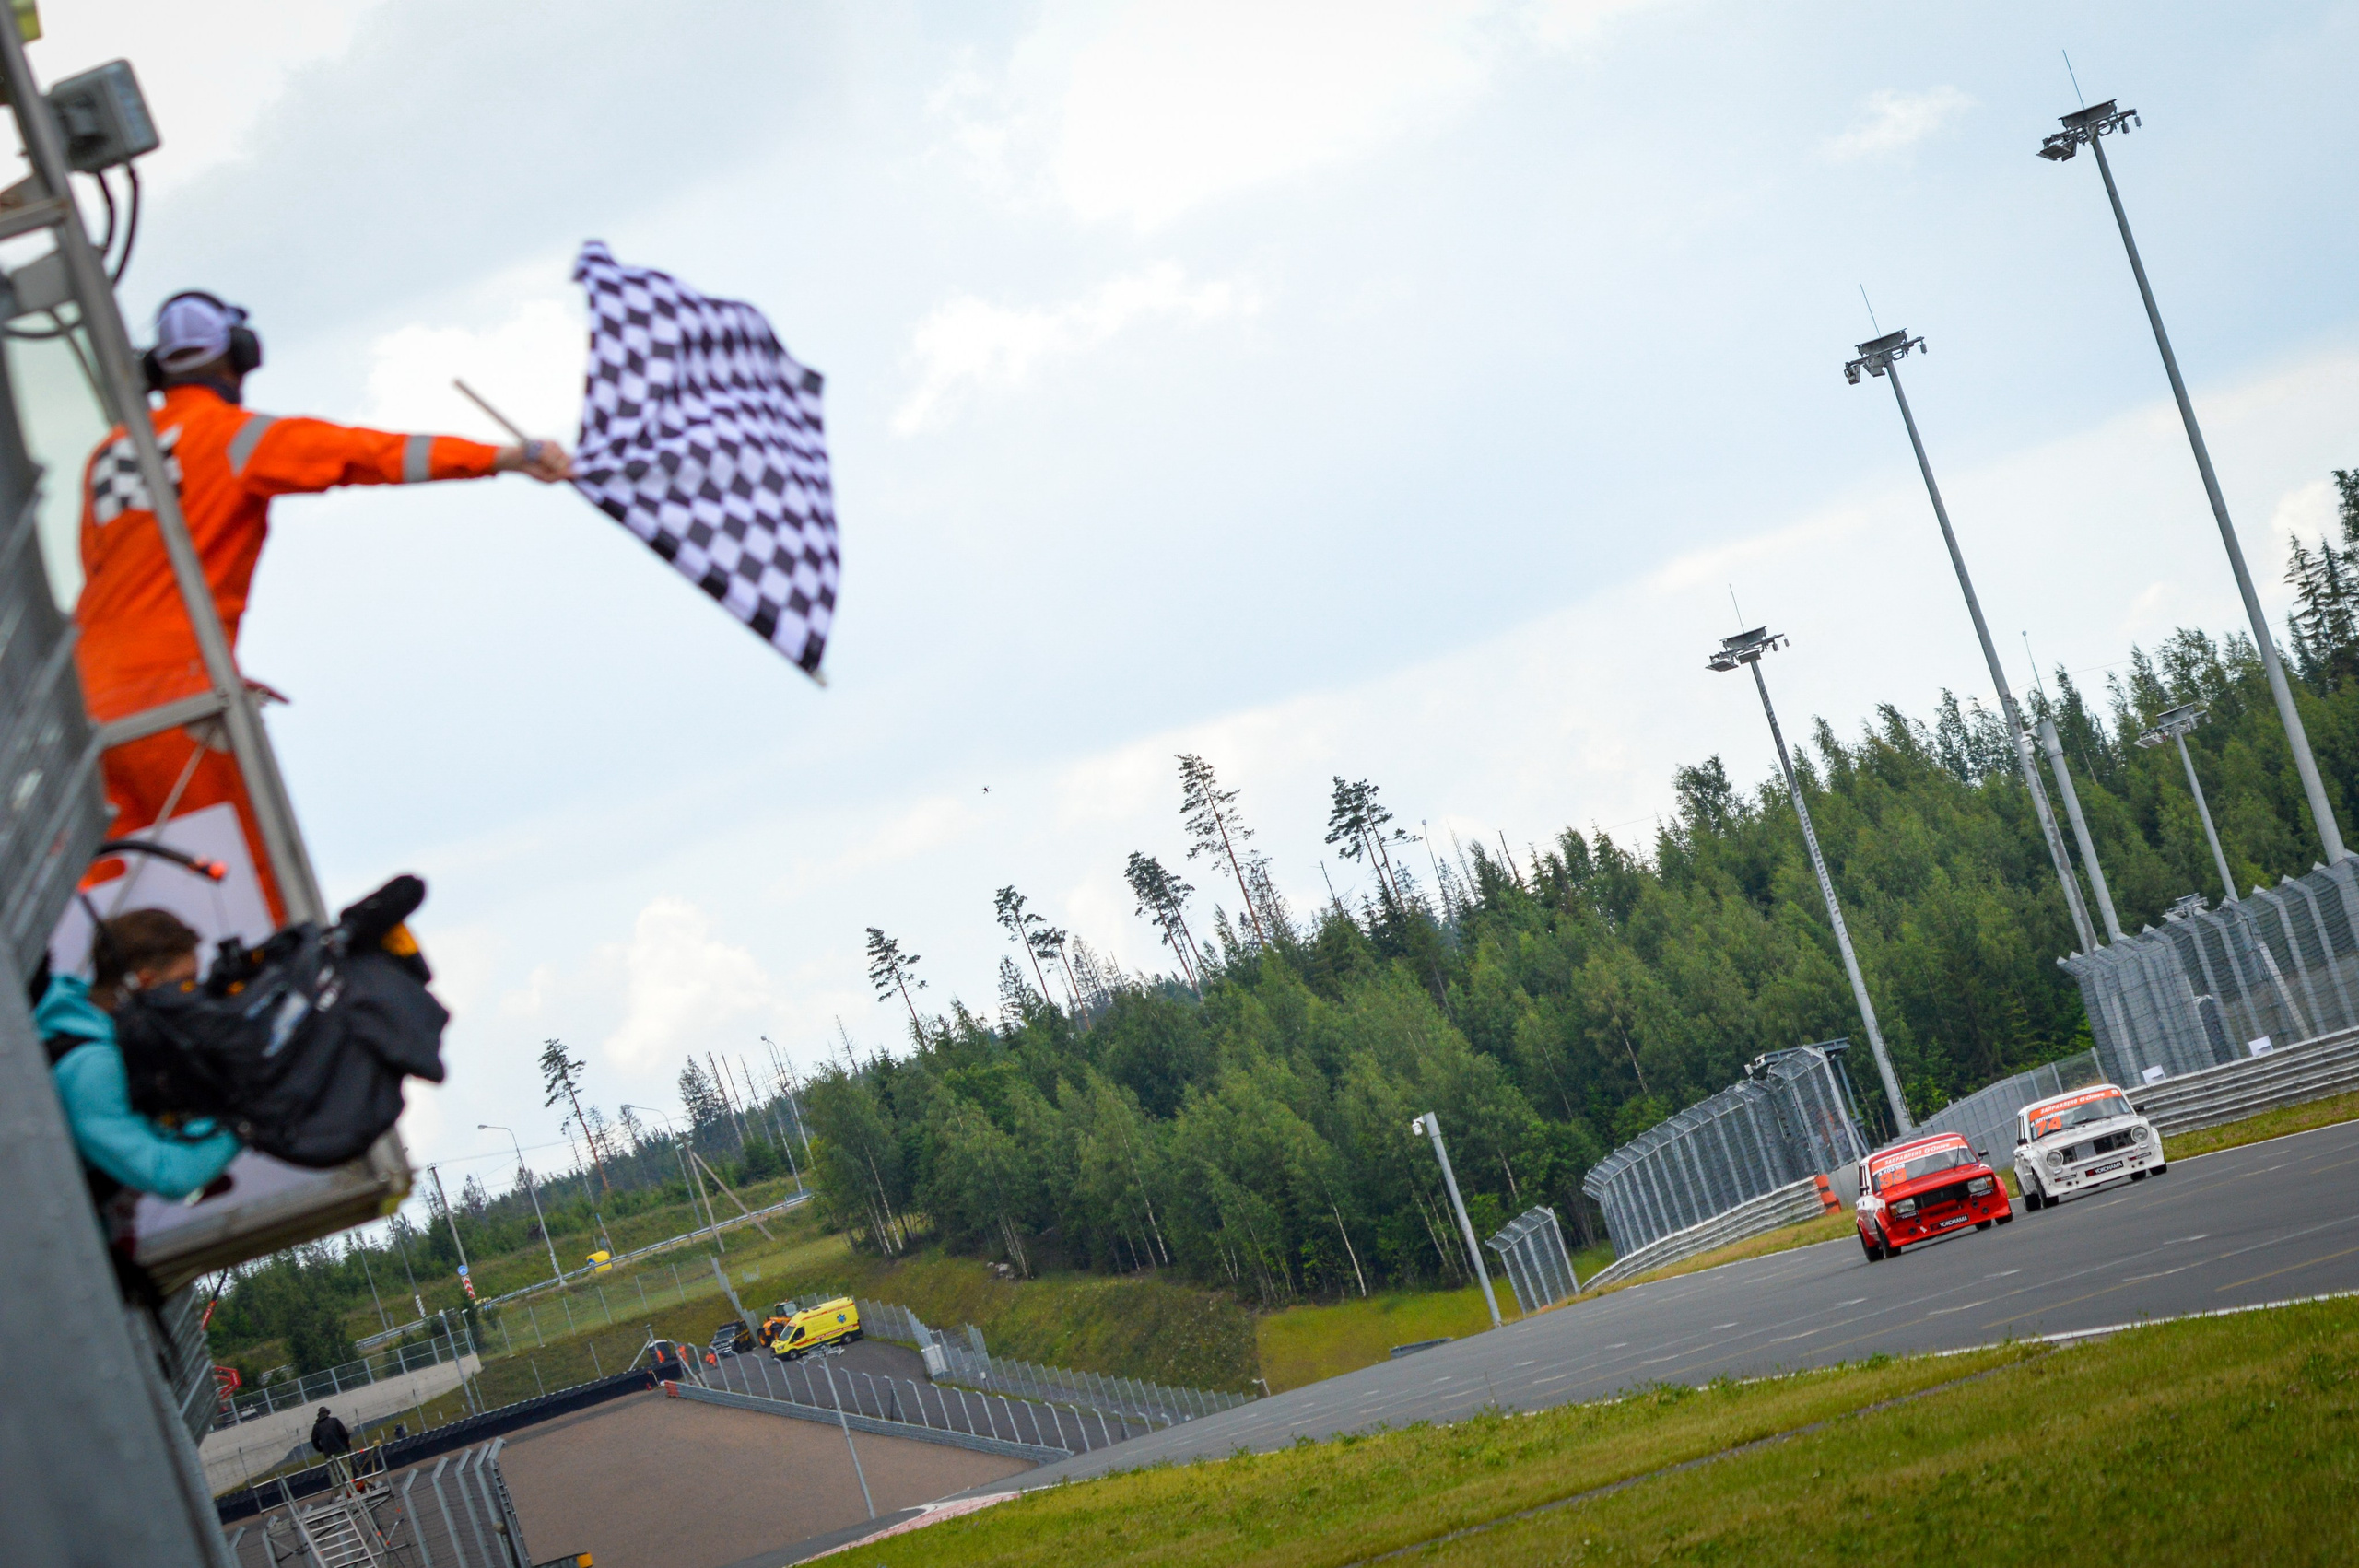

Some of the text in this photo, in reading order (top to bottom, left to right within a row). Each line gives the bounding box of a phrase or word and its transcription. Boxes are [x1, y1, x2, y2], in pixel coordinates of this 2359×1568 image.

[2040, 1099, 2078, 1114] ЗАПРАВЛЕНО
[2035, 1116, 2062, 1137] 74
[1884, 1150, 1922, 1165] ЗАПРАВЛЕНО
[2095, 1162, 2123, 1174] YOKOHAMA
[1879, 1167, 1907, 1189] 33
[1939, 1215, 1968, 1227] YOKOHAMA
